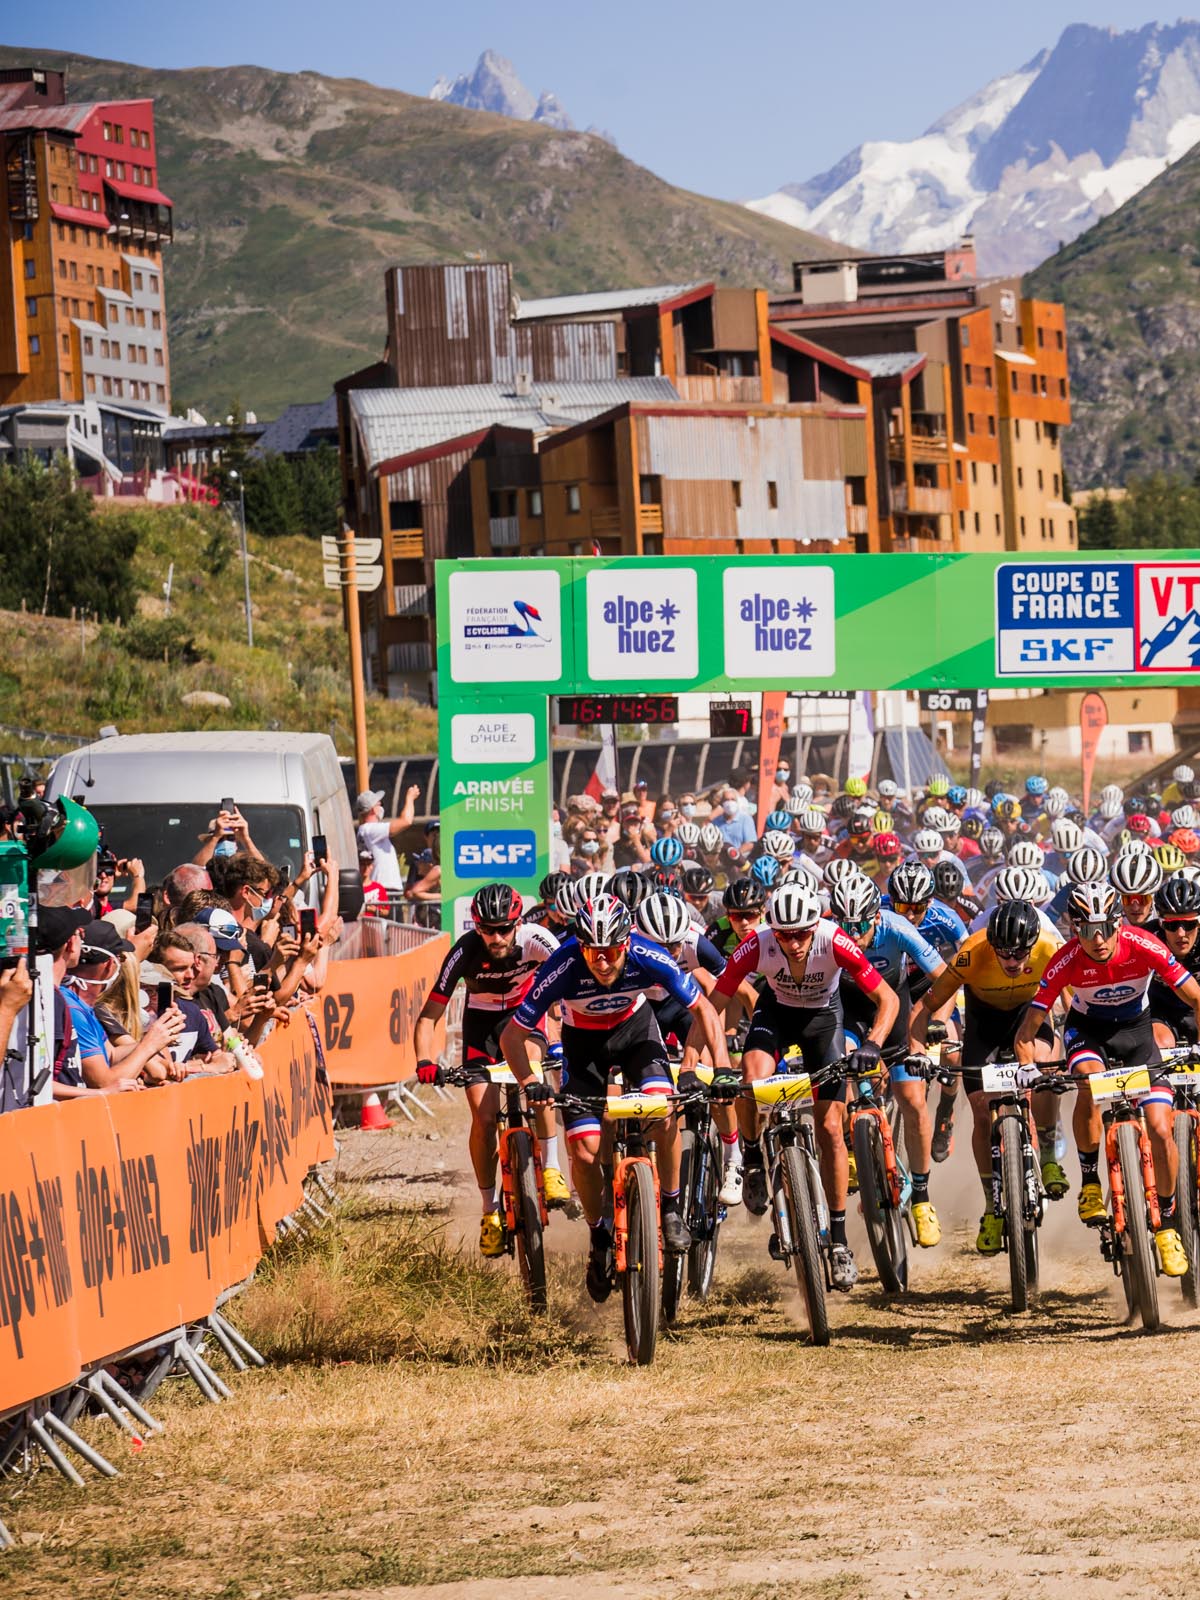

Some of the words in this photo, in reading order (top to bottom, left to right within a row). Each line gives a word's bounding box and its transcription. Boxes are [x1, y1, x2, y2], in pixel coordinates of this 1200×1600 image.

[1012, 572, 1084, 593] COUPE
[1091, 571, 1120, 592] DE
[603, 595, 654, 626] alpe
[740, 593, 791, 624] alpe
[1012, 593, 1121, 620] FRANCE
[618, 626, 676, 653] huez
[755, 624, 813, 652] huez
[1020, 638, 1113, 661] SKF
[571, 700, 675, 723] 16:14:56
[927, 694, 952, 710] 50
[955, 697, 972, 710] m
[478, 722, 510, 733] ALPE
[735, 709, 749, 733] 7
[470, 732, 518, 745] D'HUEZ
[453, 777, 535, 796] ARRIVÉE
[465, 796, 524, 812] FINISH
[458, 844, 527, 864] SKF
[732, 936, 758, 963] BMC
[833, 932, 863, 959] BMC
[1121, 931, 1168, 959] ORBEA
[1046, 943, 1082, 980] ORBEA
[532, 956, 576, 1001] ORBEA
[590, 999, 629, 1010] KMC
[1097, 988, 1133, 998] KMC
[996, 1069, 1014, 1079] 40
[1116, 1078, 1125, 1089] 5
[633, 1103, 643, 1114] 3
[76, 1139, 114, 1318] alpe
[116, 1132, 171, 1275] huez
